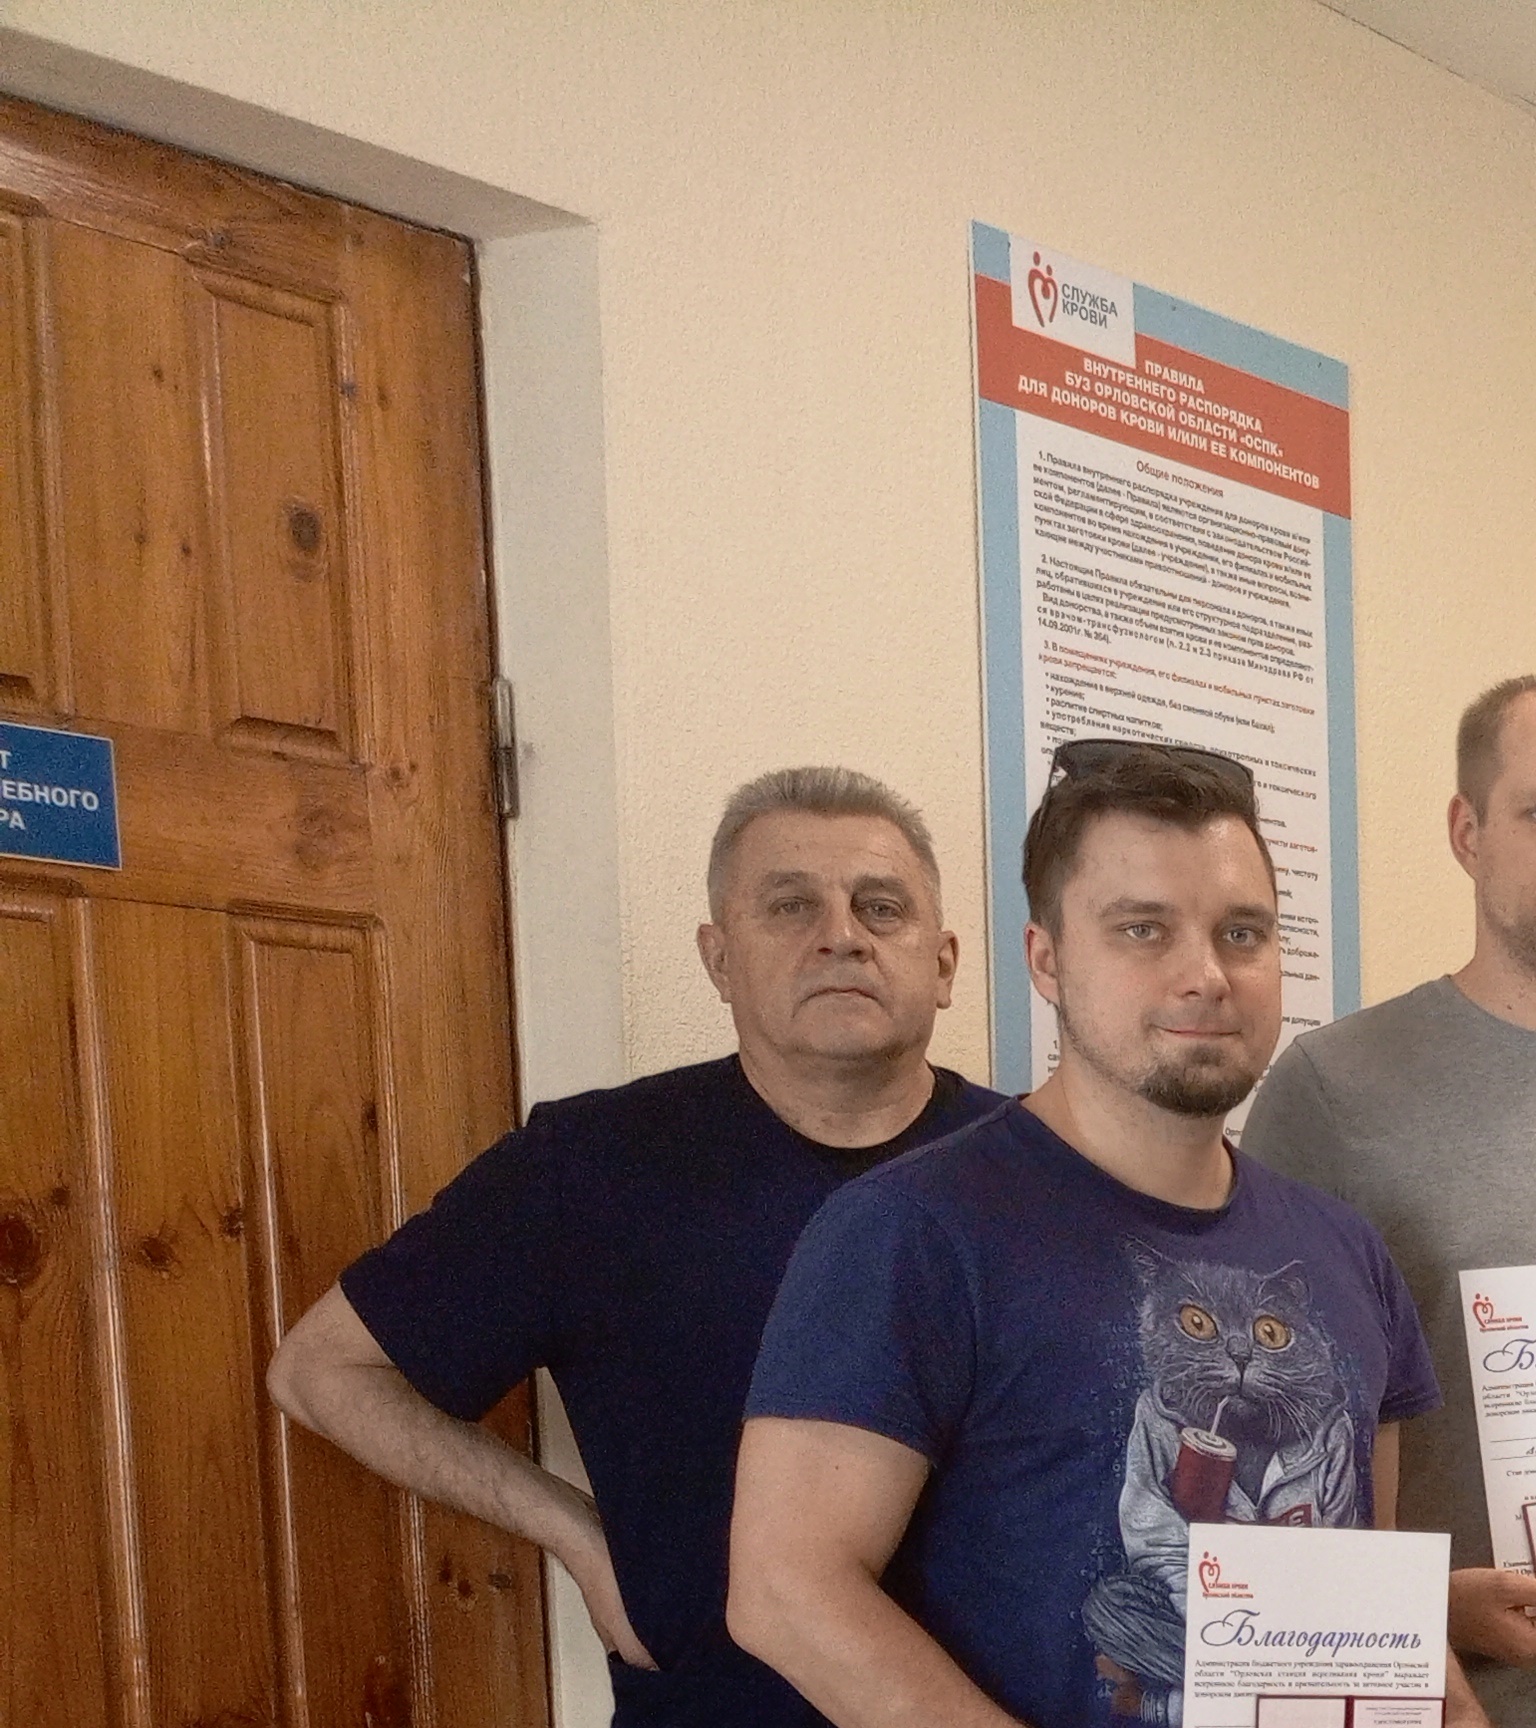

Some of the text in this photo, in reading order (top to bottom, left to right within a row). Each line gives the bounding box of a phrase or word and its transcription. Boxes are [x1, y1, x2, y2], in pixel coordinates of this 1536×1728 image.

[1061, 281, 1117, 317] СЛУЖБА
[1061, 298, 1107, 329] КРОВИ
[1084, 358, 1261, 434] ВНУТРЕННЕГО РАСПОРЯДКА
[1144, 359, 1204, 394] ПРАВИЛА
[1064, 371, 1091, 393] БУЗ
[1094, 379, 1175, 421] ОРЛОВСКОЙ
[1178, 410, 1237, 443] ОБЛАСТИ
[1018, 374, 1319, 490] ДЛЯ ДОНОРОВ КРОВИ И/ИЛИ ЕЕ КОМПОНЕНТОВ
[1136, 459, 1223, 499] Общие положения
[2, 780, 98, 811] ЕБНОГО
[1200, 1609, 1422, 1658] Благодарность
